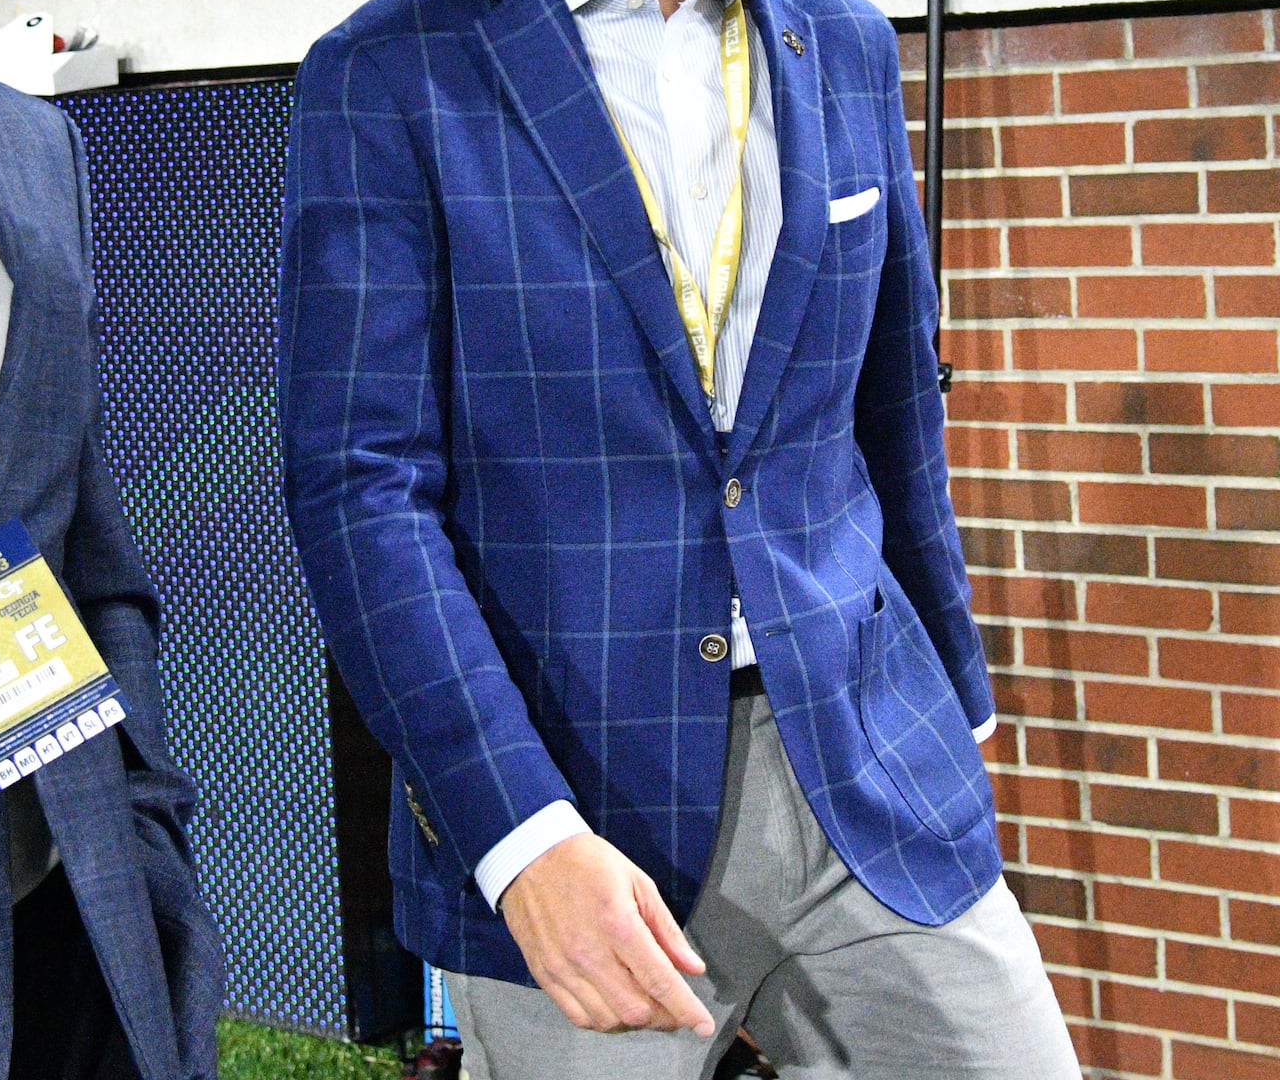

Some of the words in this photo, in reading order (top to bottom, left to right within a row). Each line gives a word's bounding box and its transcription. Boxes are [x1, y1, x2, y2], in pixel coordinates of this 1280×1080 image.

[10, 601, 39, 622] TECH
[15, 613, 68, 663] FE
[63, 730, 76, 742] VT
[105, 706, 119, 718] PS
